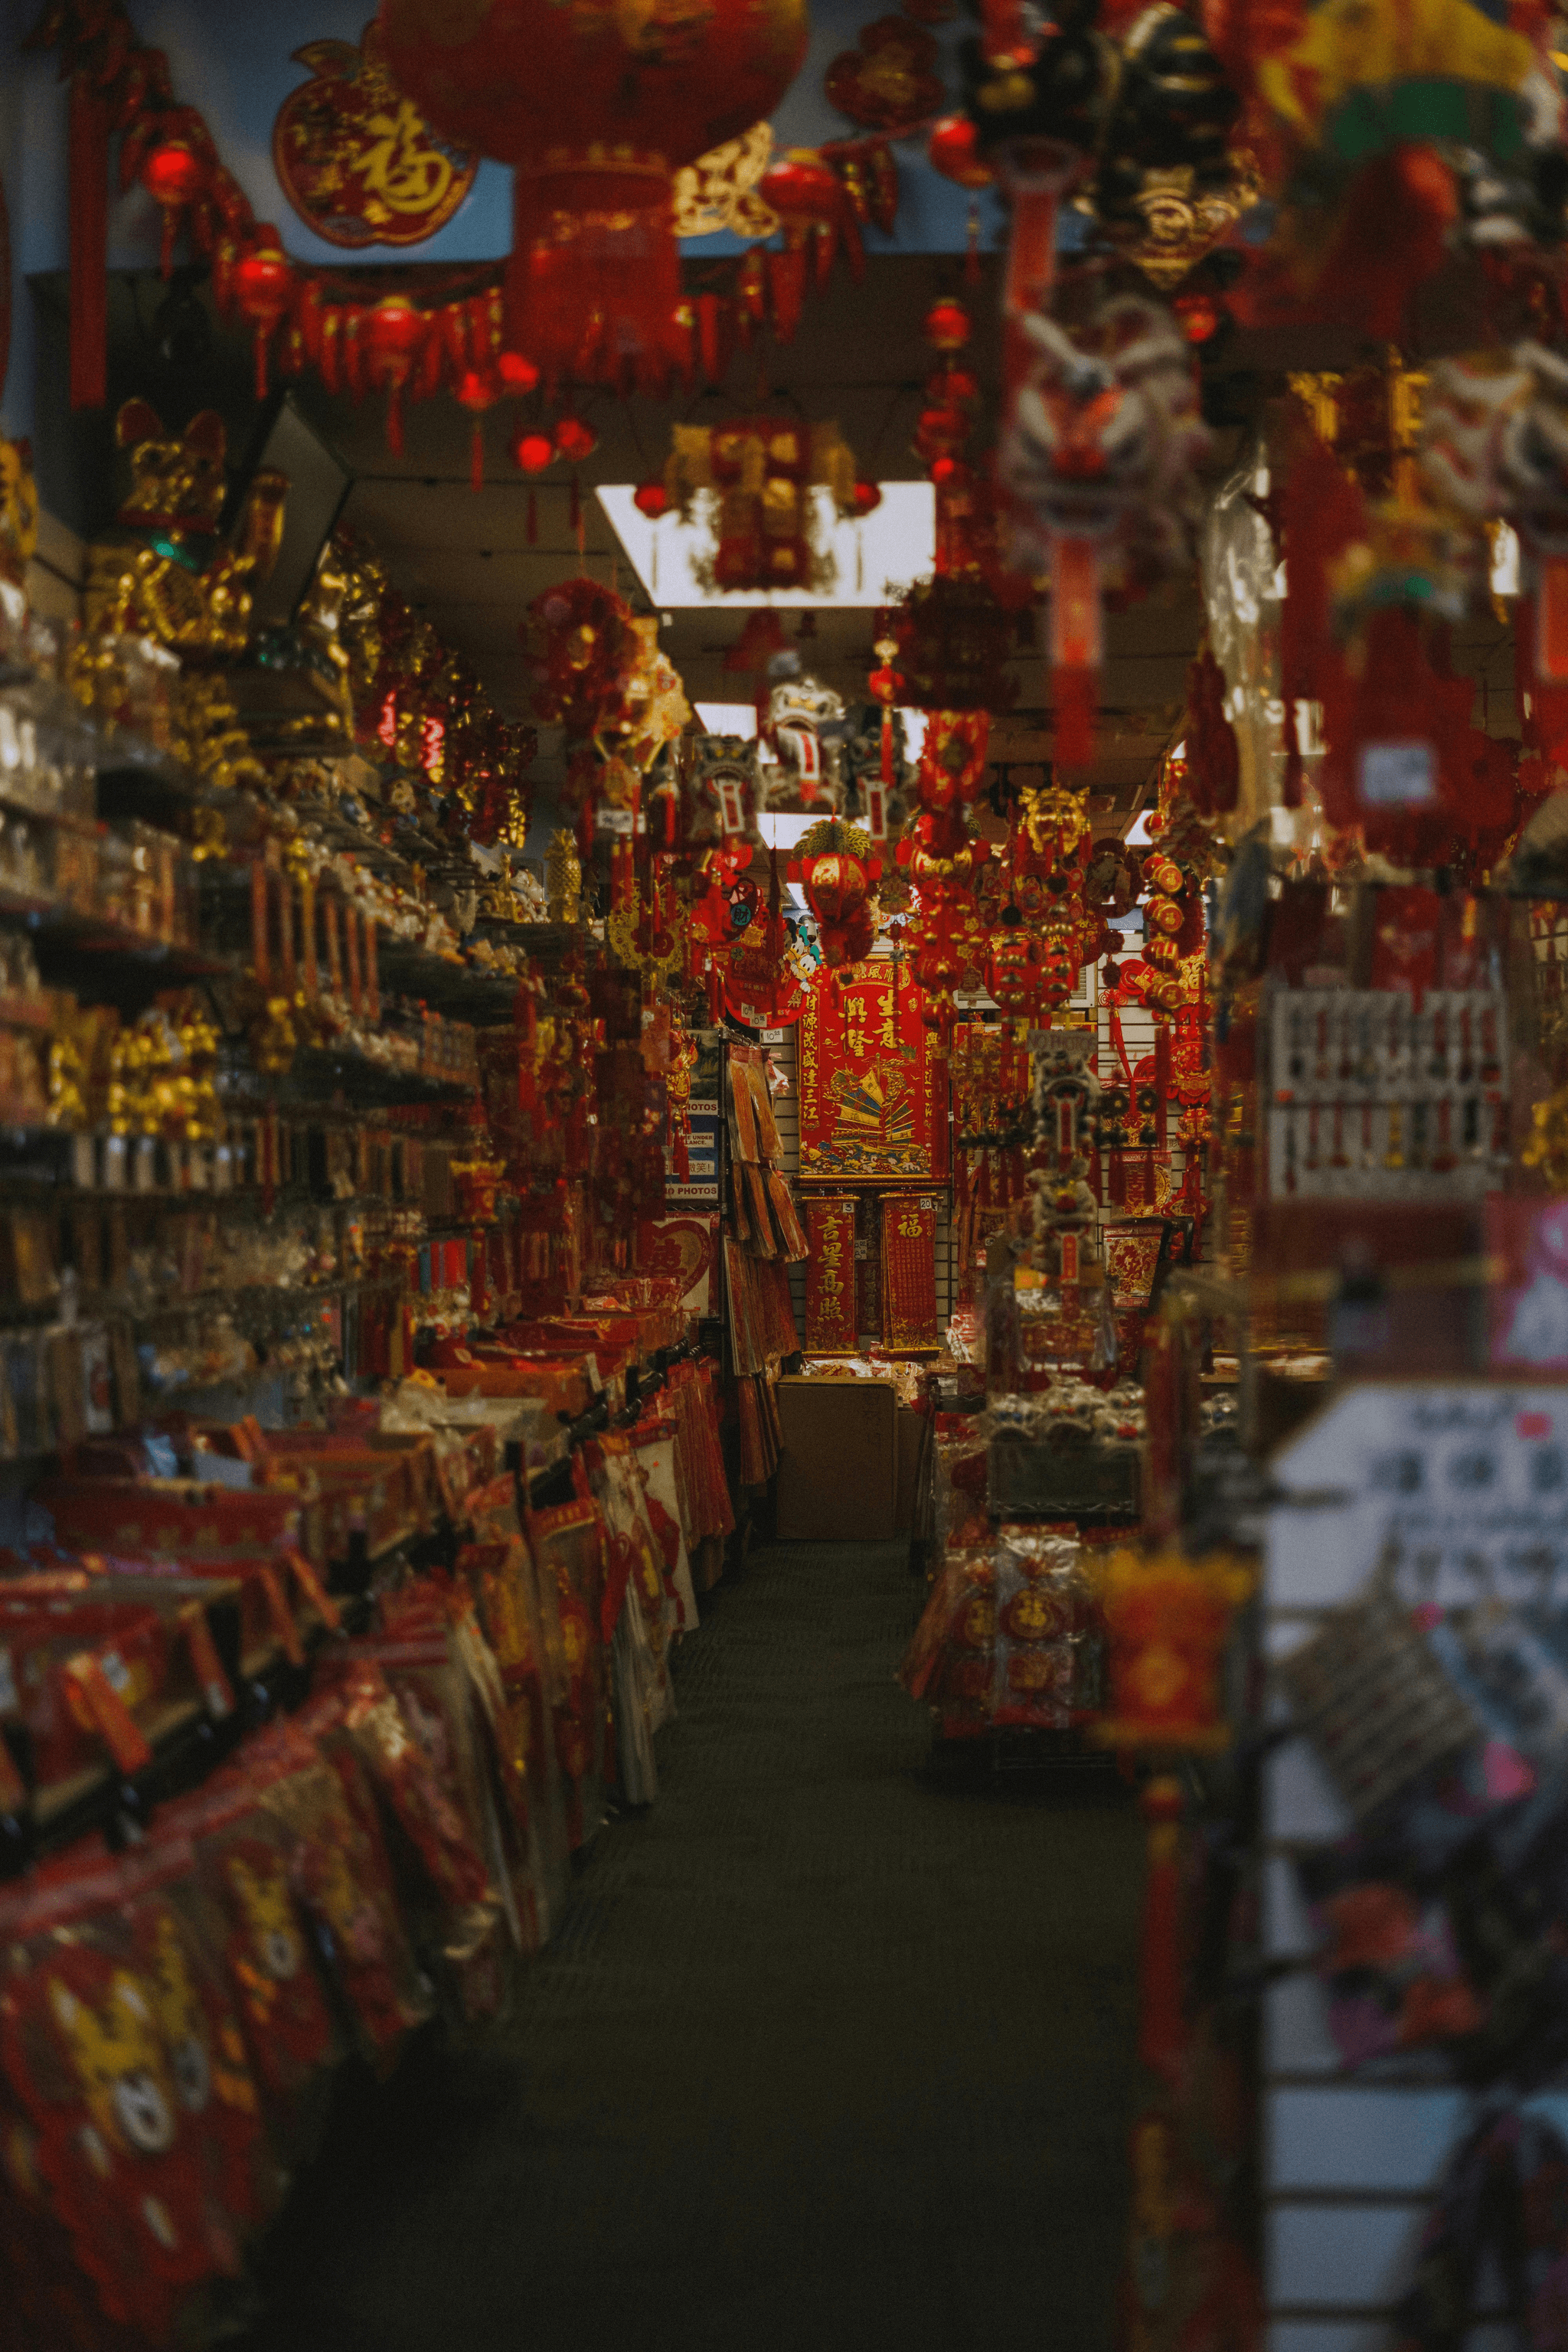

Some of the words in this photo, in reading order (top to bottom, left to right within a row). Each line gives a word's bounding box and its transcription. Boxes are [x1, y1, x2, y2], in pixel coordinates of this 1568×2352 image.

[733, 907, 750, 923] 財
[838, 996, 874, 1057] 興隆
[872, 989, 905, 1049] 生意
[802, 995, 819, 1119] 財源茂盛達三江
[897, 1214, 923, 1238] 福
[817, 1216, 844, 1323] 吉星高照
